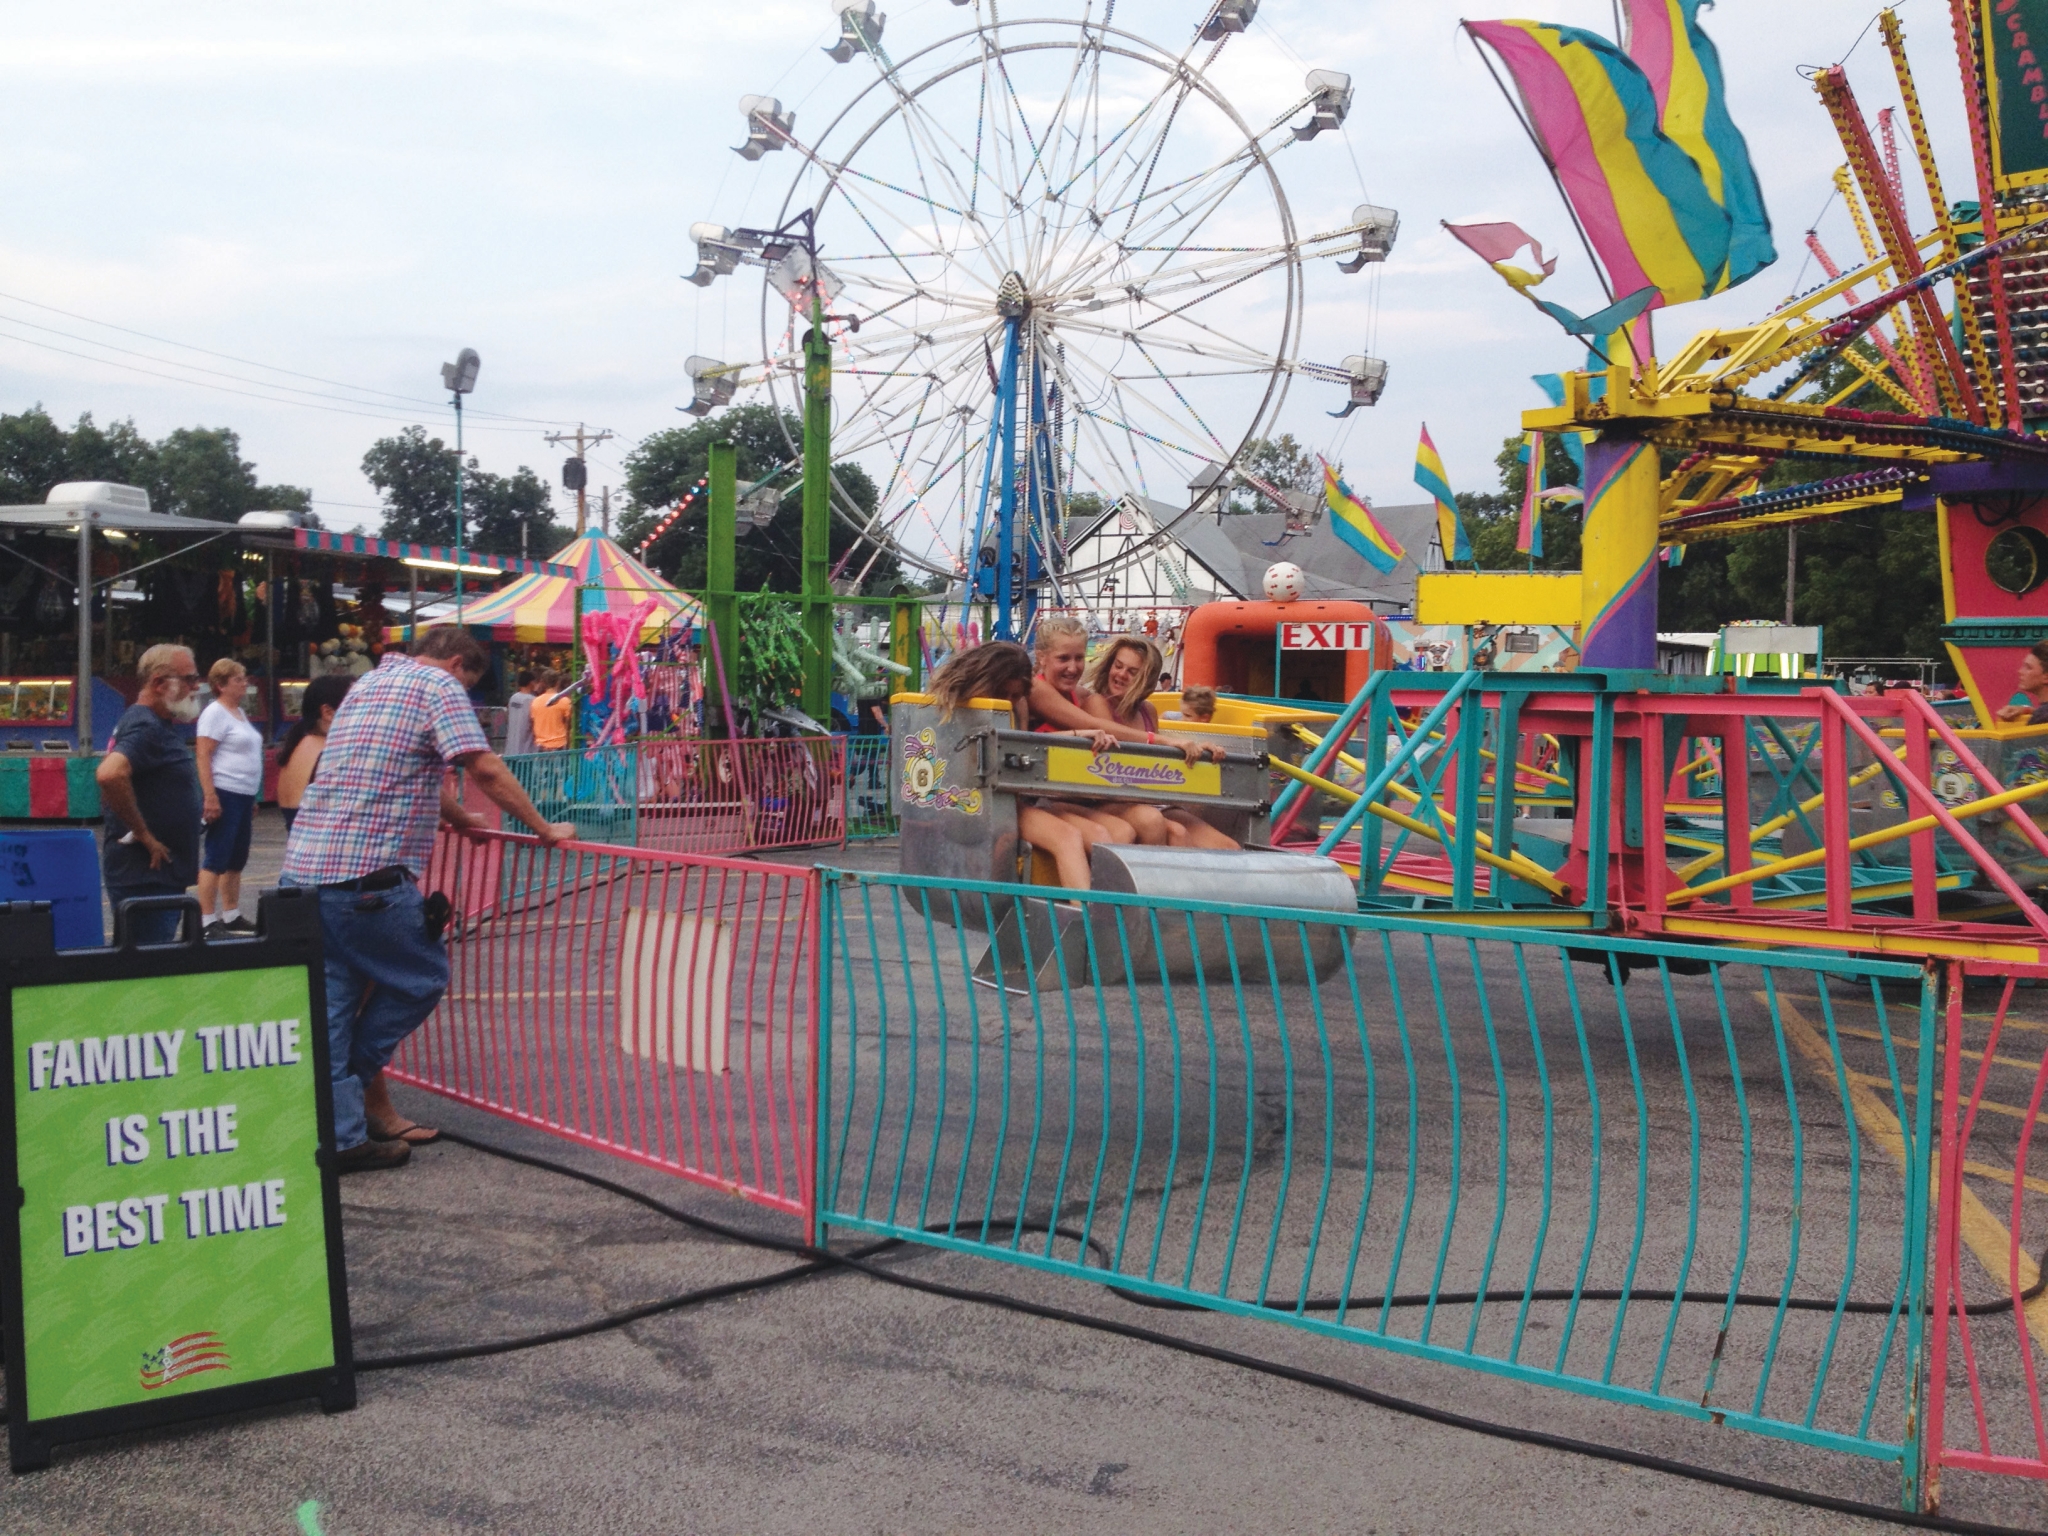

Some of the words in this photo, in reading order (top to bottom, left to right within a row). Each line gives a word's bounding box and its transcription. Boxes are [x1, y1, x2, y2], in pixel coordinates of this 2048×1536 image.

[1282, 624, 1369, 648] EXIT
[917, 768, 929, 787] 6
[1086, 753, 1186, 784] Scrambler
[28, 1030, 186, 1091] FAMILY
[196, 1019, 301, 1075] TIME
[105, 1115, 150, 1167] IS
[159, 1104, 238, 1160] THE
[62, 1194, 168, 1257] BEST
[178, 1179, 287, 1239] TIME
